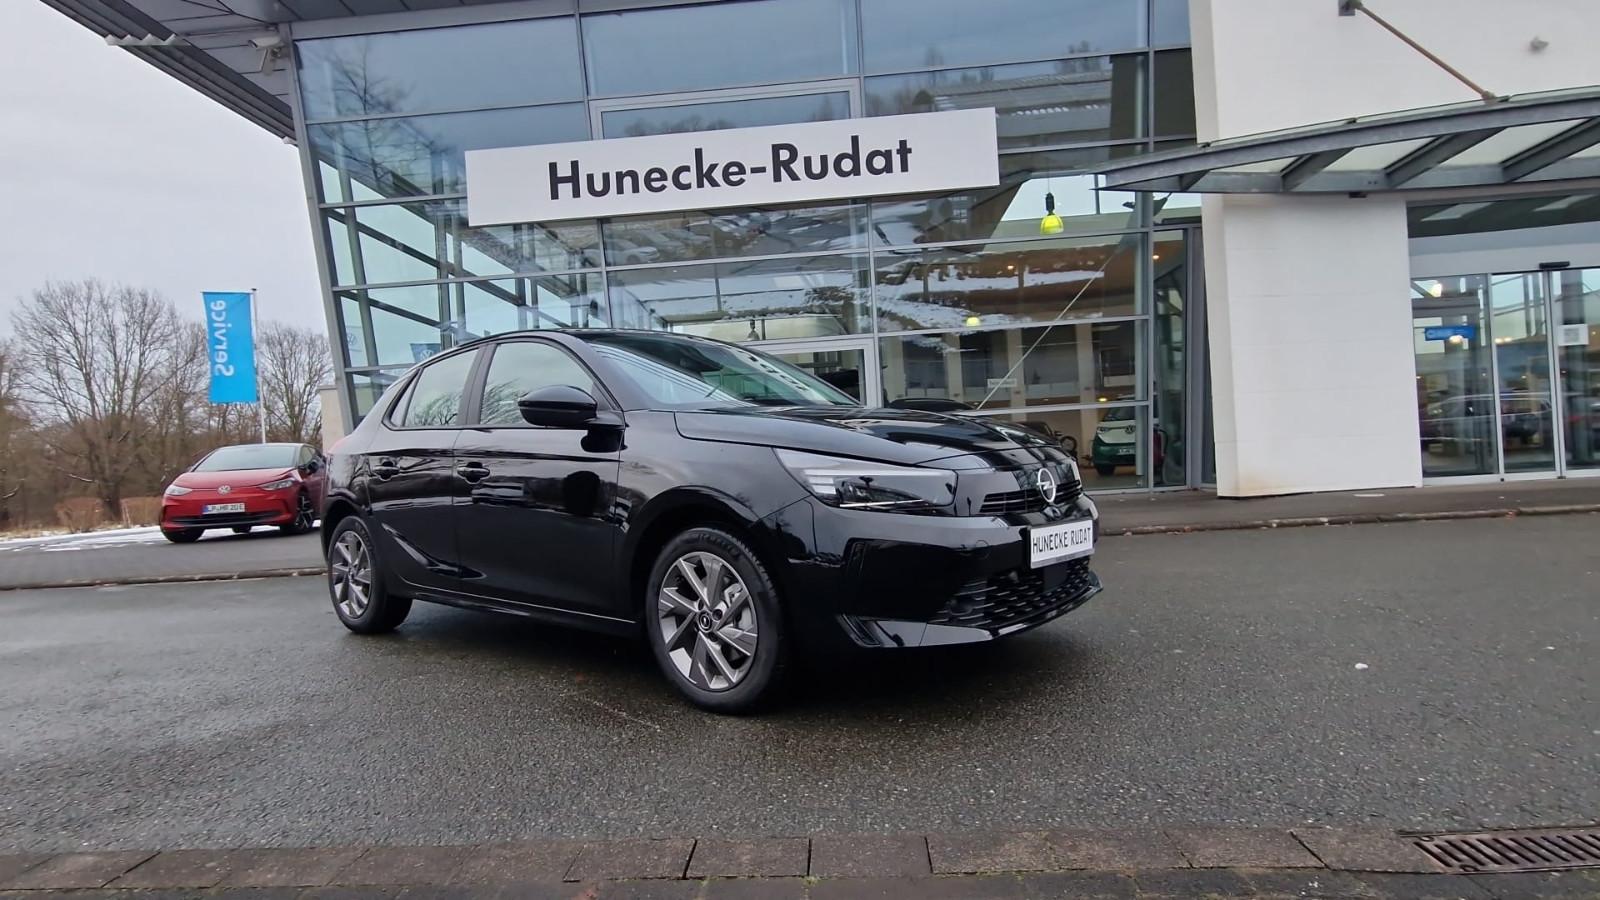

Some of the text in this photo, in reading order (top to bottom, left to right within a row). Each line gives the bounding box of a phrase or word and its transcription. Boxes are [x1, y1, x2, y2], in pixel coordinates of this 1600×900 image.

[549, 135, 912, 200] Hunecke-Rudat
[1033, 528, 1090, 554] HUNECKE RUDAT
